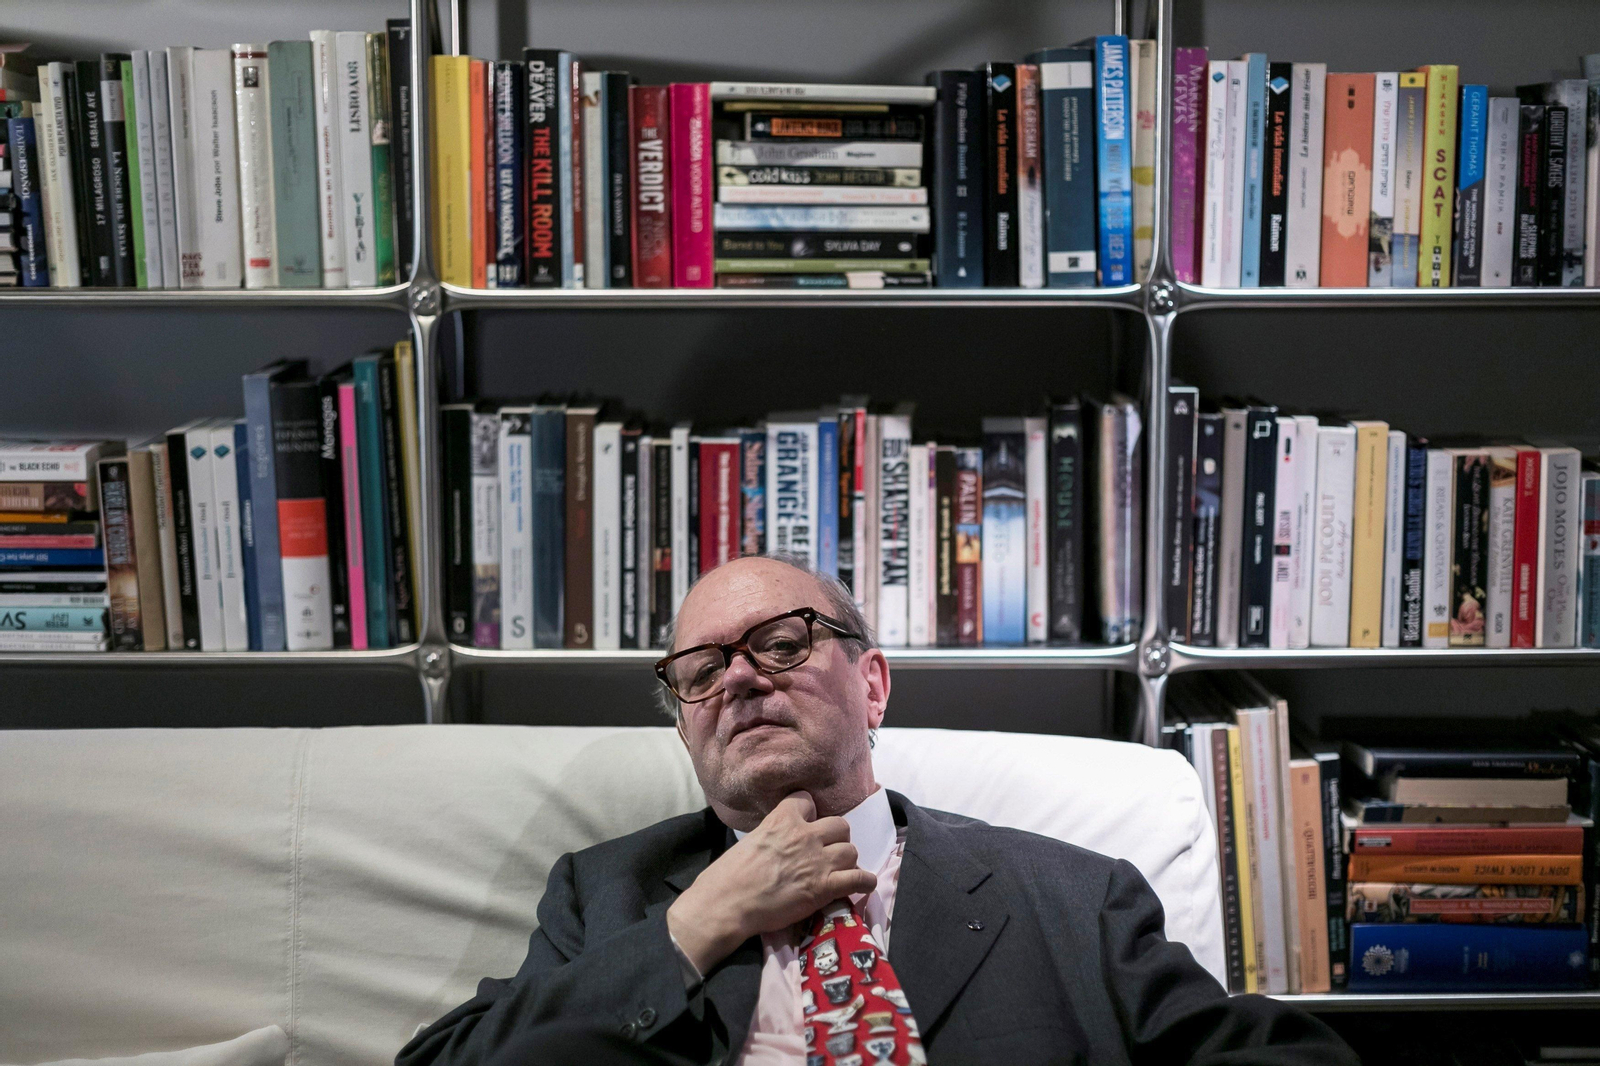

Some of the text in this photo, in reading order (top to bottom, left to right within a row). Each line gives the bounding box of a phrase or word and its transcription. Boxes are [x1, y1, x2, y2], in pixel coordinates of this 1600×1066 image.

[529, 59, 545, 124] DEAVER
[997, 109, 1008, 122] La
[1102, 42, 1125, 141] JAMES PATTERSON
[1273, 111, 1284, 124] La
[997, 123, 1008, 145] vida
[1273, 125, 1284, 147] vida
[1467, 91, 1481, 177] GERAINT THOMAS
[1550, 110, 1566, 148] DOROTHY
[92, 157, 106, 225] 17 MILAGROSO
[532, 126, 552, 258] THE KILL ROOM
[638, 139, 664, 214] VERDICT
[1433, 148, 1448, 218] SCAT
[1548, 157, 1564, 188] SAYERS
[959, 472, 976, 525] PALIN
[1552, 463, 1568, 571] JOJO MOYES
[1317, 492, 1336, 607] JODI PICOULT
[1508, 866, 1537, 876] LOOK
